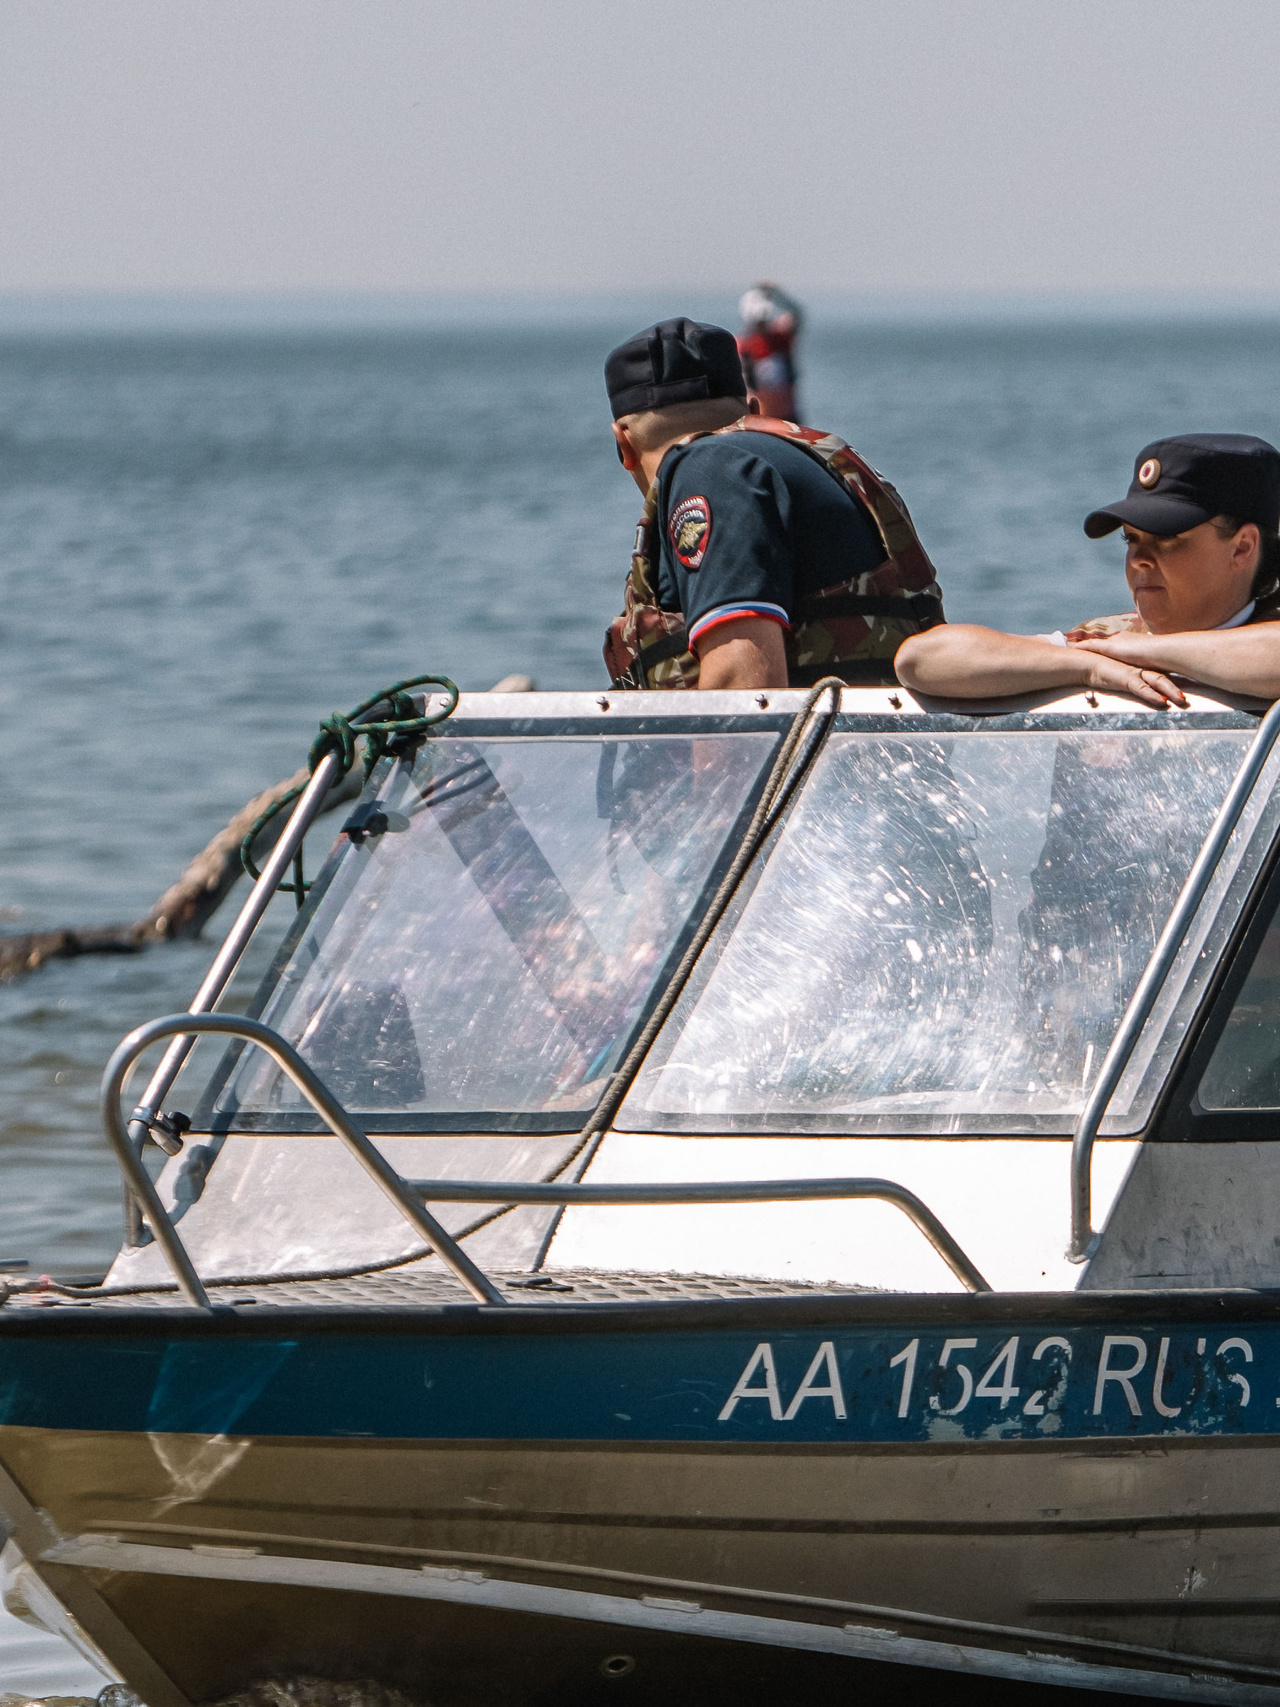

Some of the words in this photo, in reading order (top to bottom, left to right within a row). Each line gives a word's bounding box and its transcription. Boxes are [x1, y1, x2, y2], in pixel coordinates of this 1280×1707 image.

[718, 1342, 847, 1420] AA
[889, 1336, 1073, 1418] 1542
[1093, 1335, 1253, 1417] RUS
